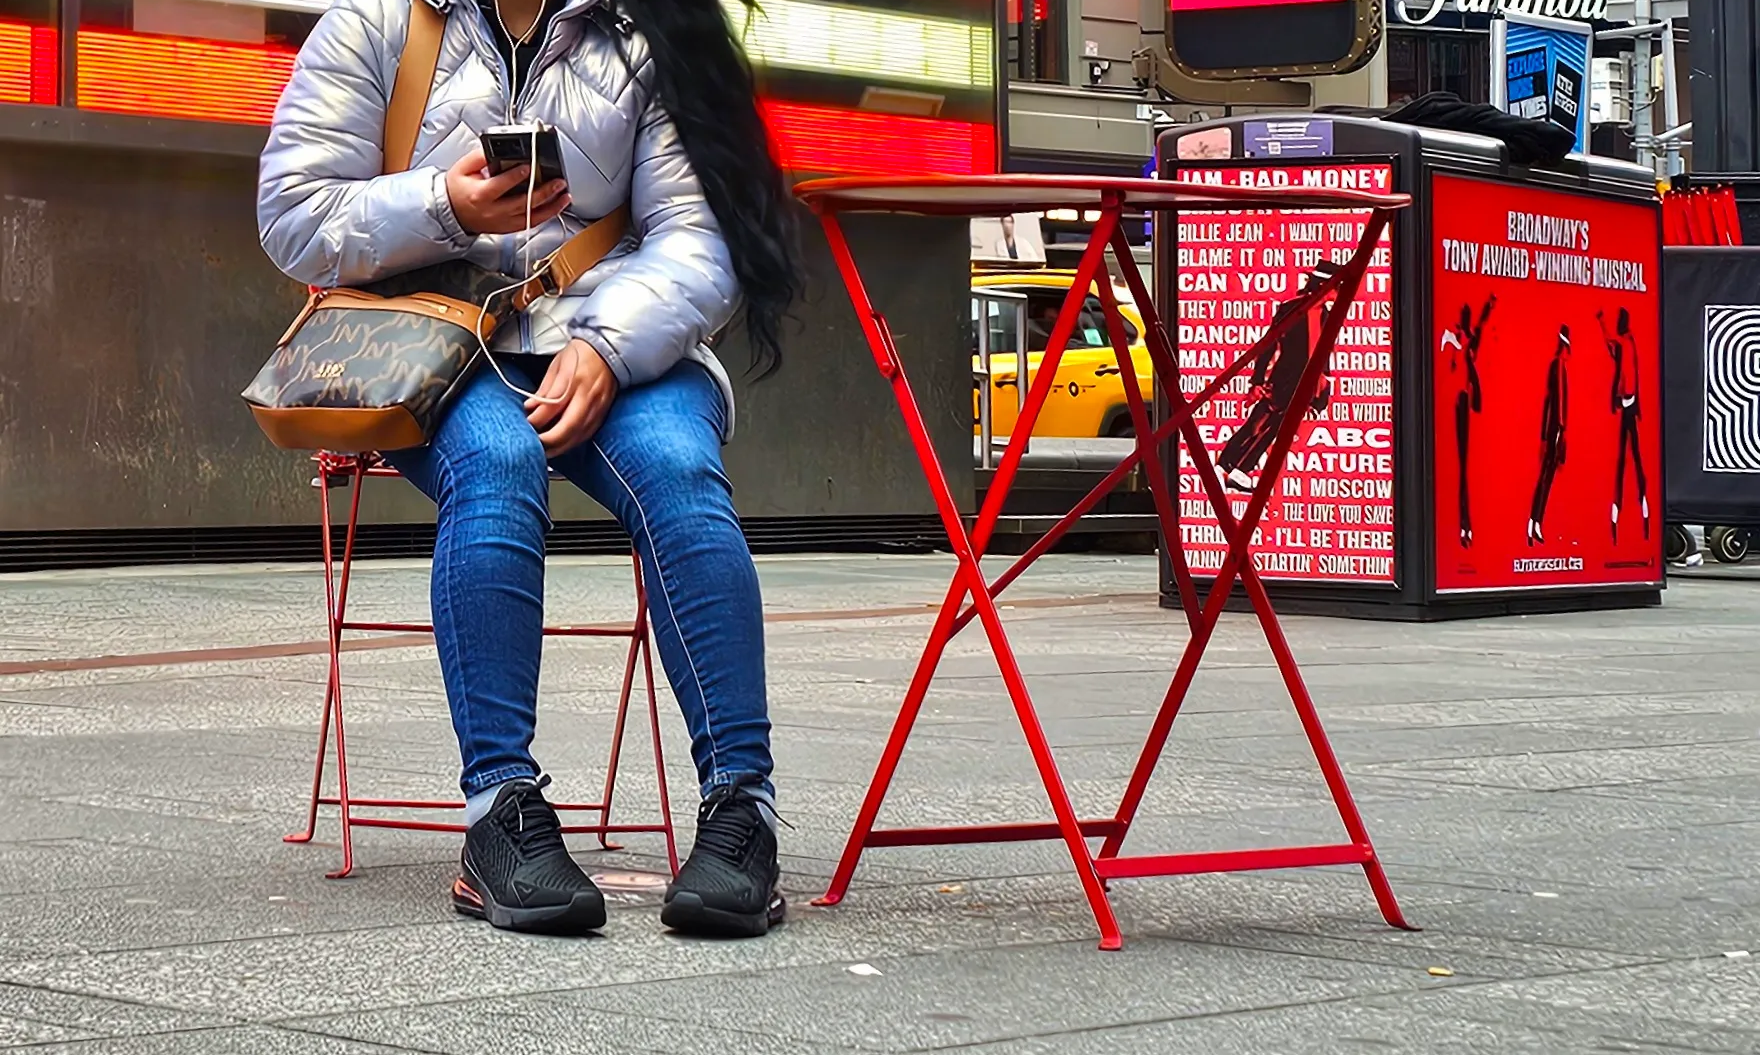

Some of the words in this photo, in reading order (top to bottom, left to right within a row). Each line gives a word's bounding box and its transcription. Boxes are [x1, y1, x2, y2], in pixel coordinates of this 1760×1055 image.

[1239, 170, 1289, 187] BAD
[1302, 169, 1388, 188] MONEY
[1177, 223, 1222, 242] BILLIE
[1225, 223, 1263, 242] JEAN
[1289, 223, 1324, 243] WANT
[1327, 223, 1353, 242] YOU
[1508, 210, 1590, 251] BROADWAY'S
[1177, 248, 1233, 267] BLAME
[1239, 248, 1256, 267] IT
[1262, 248, 1286, 267] ON
[1331, 247, 1391, 267] BOIE
[1442, 238, 1479, 274] TONY
[1592, 257, 1647, 292] MUSICAL
[1178, 272, 1228, 293] CAN
[1237, 272, 1287, 293] YOU
[1366, 273, 1391, 293] IT
[1178, 300, 1217, 320] THEY
[1222, 301, 1266, 320] DON'T
[1370, 301, 1391, 321] US
[1334, 326, 1391, 346] HINE
[1178, 349, 1225, 370] MAN
[1329, 352, 1391, 371] RROR
[1340, 377, 1391, 396] ENOUGH
[1213, 398, 1239, 417] THE
[1332, 403, 1349, 421] OR
[1352, 403, 1391, 421] WHITE
[1307, 427, 1391, 448] ABC
[1287, 453, 1392, 473] NATURE
[1282, 478, 1301, 496] IN
[1310, 478, 1393, 499] MOSCOW
[1179, 499, 1218, 518] TABLO
[1282, 503, 1304, 522] THE
[1307, 504, 1336, 523] LOVE
[1339, 505, 1361, 524] YOU
[1364, 505, 1393, 525] SAVE
[1275, 527, 1306, 547] I'LL
[1310, 528, 1332, 549] BE
[1336, 530, 1393, 550] THERE
